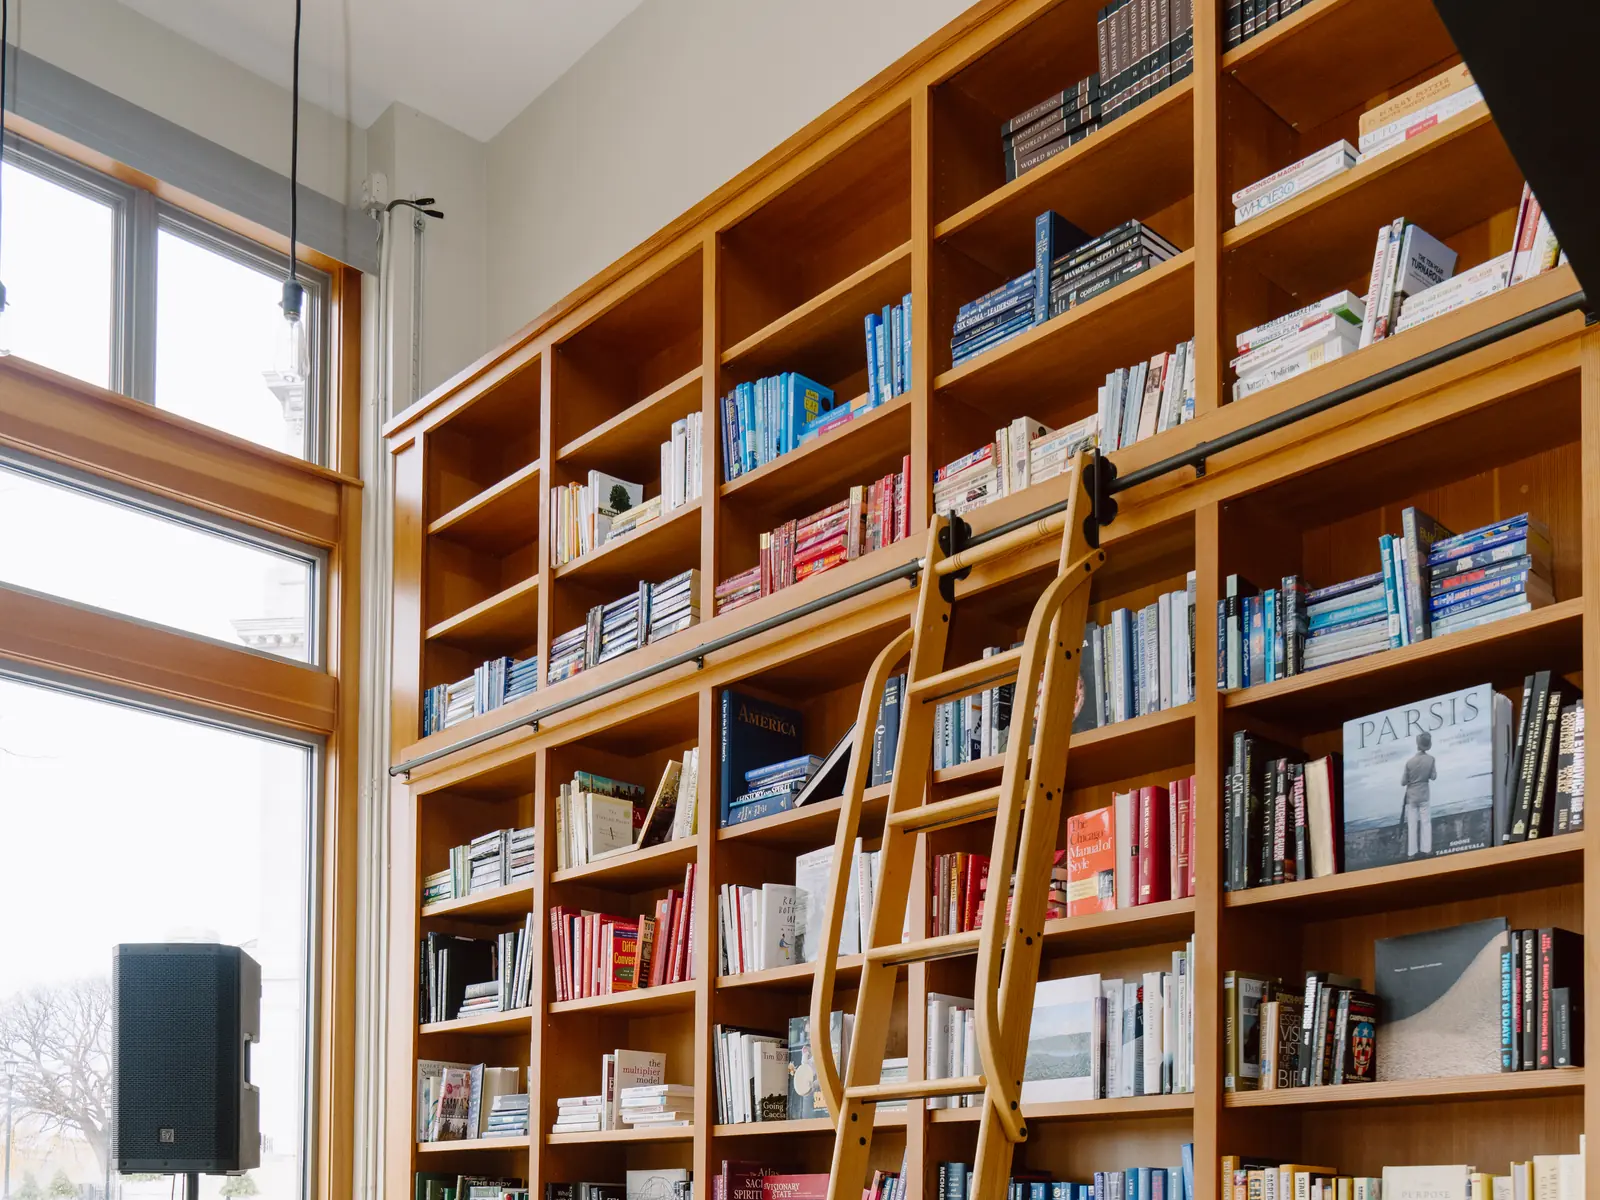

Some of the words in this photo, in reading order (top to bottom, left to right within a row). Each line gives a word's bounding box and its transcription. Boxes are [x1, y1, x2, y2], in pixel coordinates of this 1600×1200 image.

[1015, 109, 1039, 125] WORLD
[1041, 99, 1058, 111] BOOK
[1017, 124, 1041, 140] WORLD
[1042, 113, 1058, 126] BOOK
[1019, 136, 1042, 152] WORLD
[1043, 126, 1061, 140] BOOK
[1021, 153, 1045, 169] WORLD
[1046, 144, 1065, 157] BOOK
[1245, 175, 1277, 195] SPONSOR
[1277, 161, 1305, 180] MAGNET
[1064, 263, 1089, 280] MANAGING
[1096, 249, 1116, 264] SUPPLY
[1116, 239, 1133, 253] CHAIN
[1418, 252, 1429, 264] THE
[1425, 257, 1445, 275] TEN-YEAR
[1079, 277, 1110, 298] operations
[956, 320, 969, 331] SIX
[968, 312, 984, 327] SIGMA
[987, 296, 1019, 317] LEADERSHIP
[1287, 301, 1322, 321] MARKETING
[1455, 590, 1470, 601] JANET
[1471, 581, 1500, 595] EVANOVICH
[1537, 690, 1545, 711] FRANK
[738, 703, 796, 737] AMERICA
[875, 724, 885, 735] Q
[1358, 692, 1479, 749] PARSIS
[1533, 712, 1542, 739] SINATRA
[1575, 706, 1585, 737] JANET
[1525, 729, 1533, 752] NANCY
[1559, 712, 1570, 756] COULTER
[1566, 711, 1576, 755] CATHERINE
[1522, 753, 1530, 780] SINATRA
[1526, 751, 1536, 783] AMERICAN
[1572, 739, 1584, 796] EVANOVICH
[740, 789, 765, 801] HISTORY
[771, 782, 791, 793] SPIRIT
[1232, 773, 1243, 794] CAT
[1264, 772, 1272, 807] BILLY
[1557, 767, 1567, 793] TAKE
[1294, 774, 1304, 827] TRACTION
[1522, 785, 1531, 809] LEGEND
[1071, 819, 1088, 832] The
[1263, 810, 1271, 838] JOEL
[1277, 795, 1286, 837] BUTCHER'S
[1069, 843, 1101, 858] Manual
[1101, 837, 1112, 851] of
[1070, 830, 1105, 845] Chicago
[1277, 837, 1285, 861] GUIDE
[1436, 842, 1485, 856] TARAPOREVALA
[1450, 838, 1470, 846] SOONI
[1069, 860, 1090, 874] Style
[1502, 952, 1511, 972] THE
[1502, 974, 1510, 1002] FIRST
[1542, 991, 1548, 999] UP
[1303, 977, 1317, 1029] Wilderness
[1501, 1019, 1510, 1045] DAYS
[1540, 1035, 1548, 1051] TREE
[649, 1059, 661, 1067] the
[763, 1052, 775, 1060] Tim
[623, 1067, 661, 1077] multiplier
[636, 1076, 660, 1084] model
[763, 1101, 784, 1111] Going
[766, 1183, 800, 1191] VISIONARY
[772, 1190, 792, 1199] STATE
[1266, 1173, 1274, 1200] SACRED
[1298, 1177, 1306, 1199] START
[1401, 1190, 1451, 1199] PURPOSE
